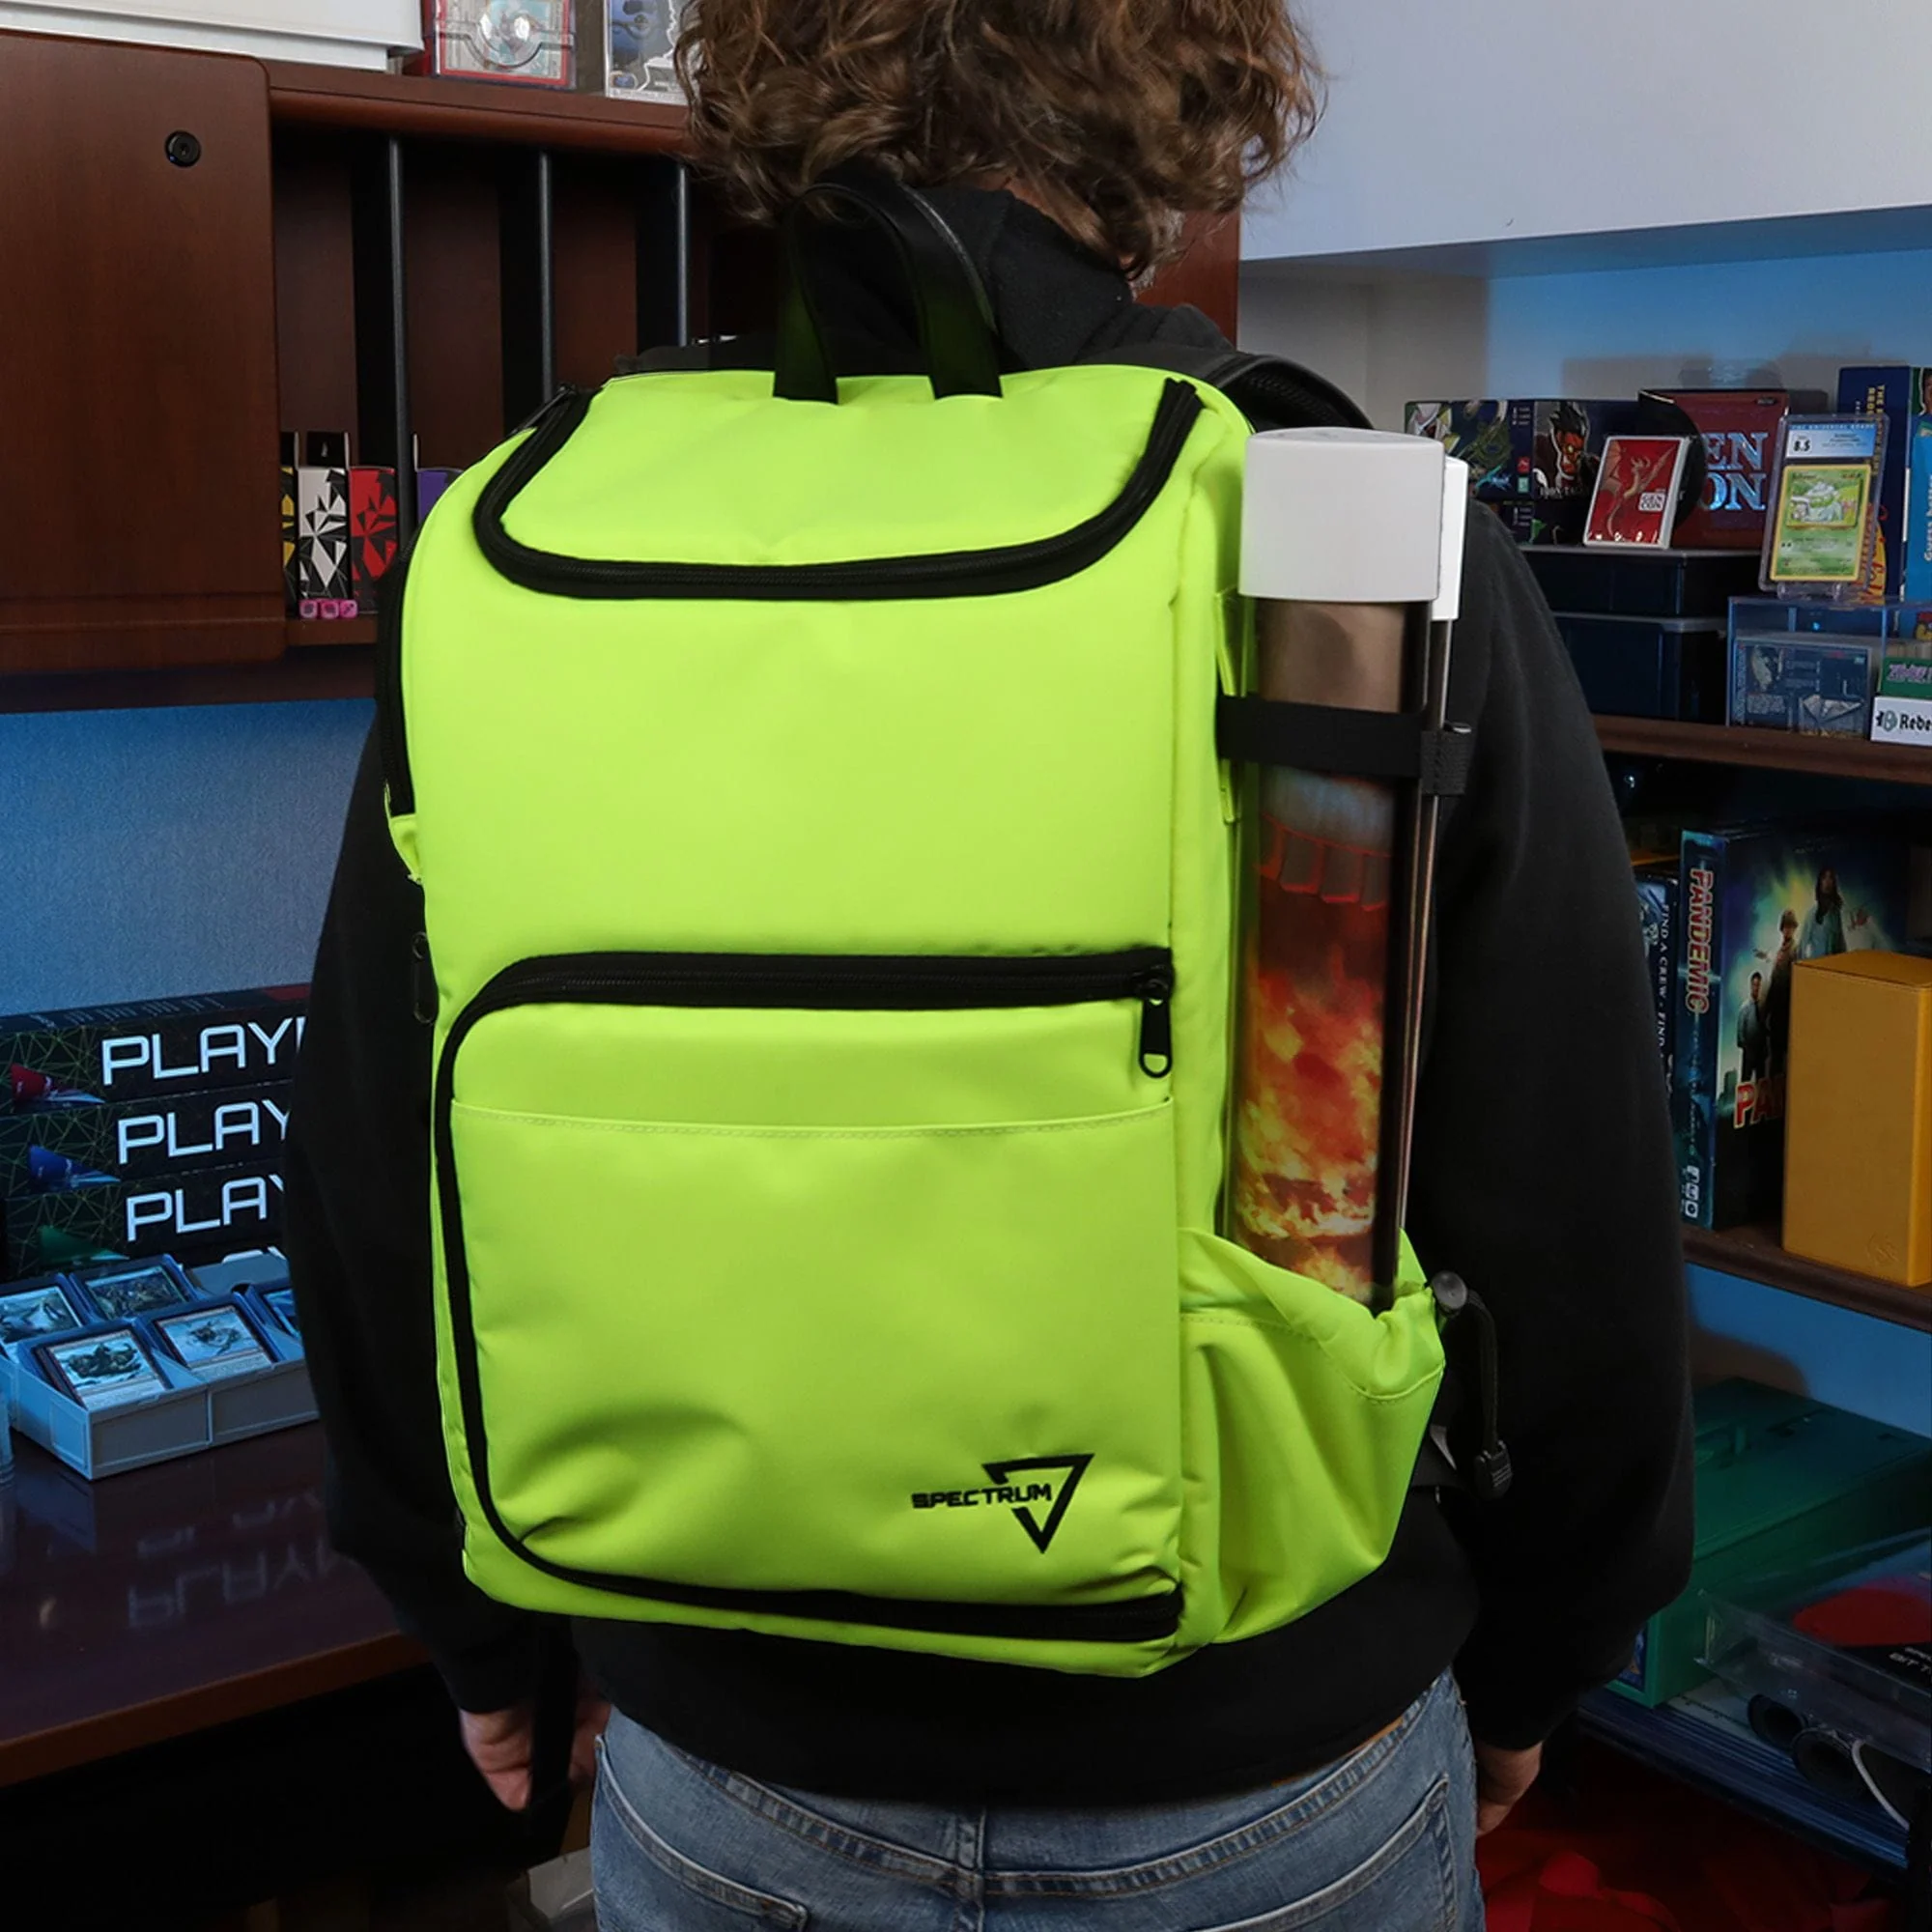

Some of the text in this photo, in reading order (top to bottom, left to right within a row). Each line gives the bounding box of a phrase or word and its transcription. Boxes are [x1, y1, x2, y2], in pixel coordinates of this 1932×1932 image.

[1701, 433, 1769, 470] EN
[1793, 440, 1810, 453] 8.5
[1699, 472, 1767, 511] ON
[1661, 903, 1670, 940] FIND
[1660, 942, 1669, 953] A
[1685, 867, 1715, 1014] PANDEMIC
[1658, 955, 1668, 999] CREW
[101, 1015, 307, 1087] PLAY
[911, 1483, 1052, 1509] SPECTRUM
